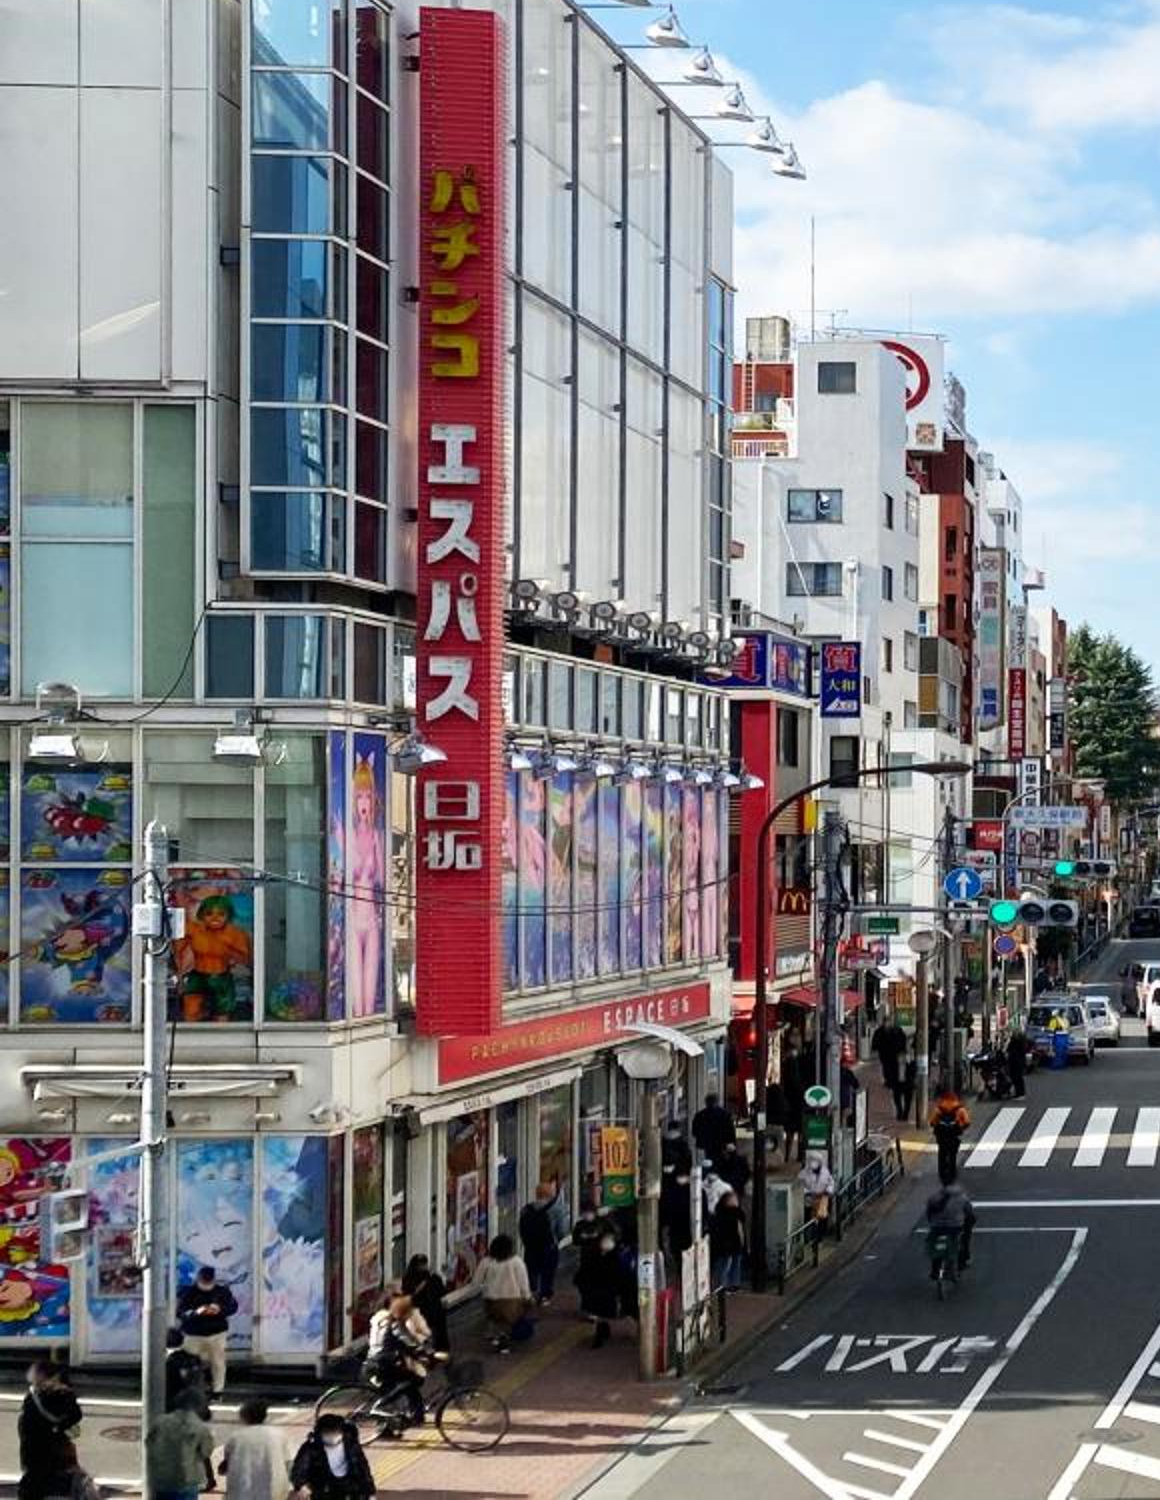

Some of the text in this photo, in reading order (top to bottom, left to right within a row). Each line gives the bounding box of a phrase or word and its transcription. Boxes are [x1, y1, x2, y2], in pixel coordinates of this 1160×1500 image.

[429, 164, 481, 377] パチンコ
[423, 423, 481, 722] エスパス
[422, 780, 483, 871] 日拓
